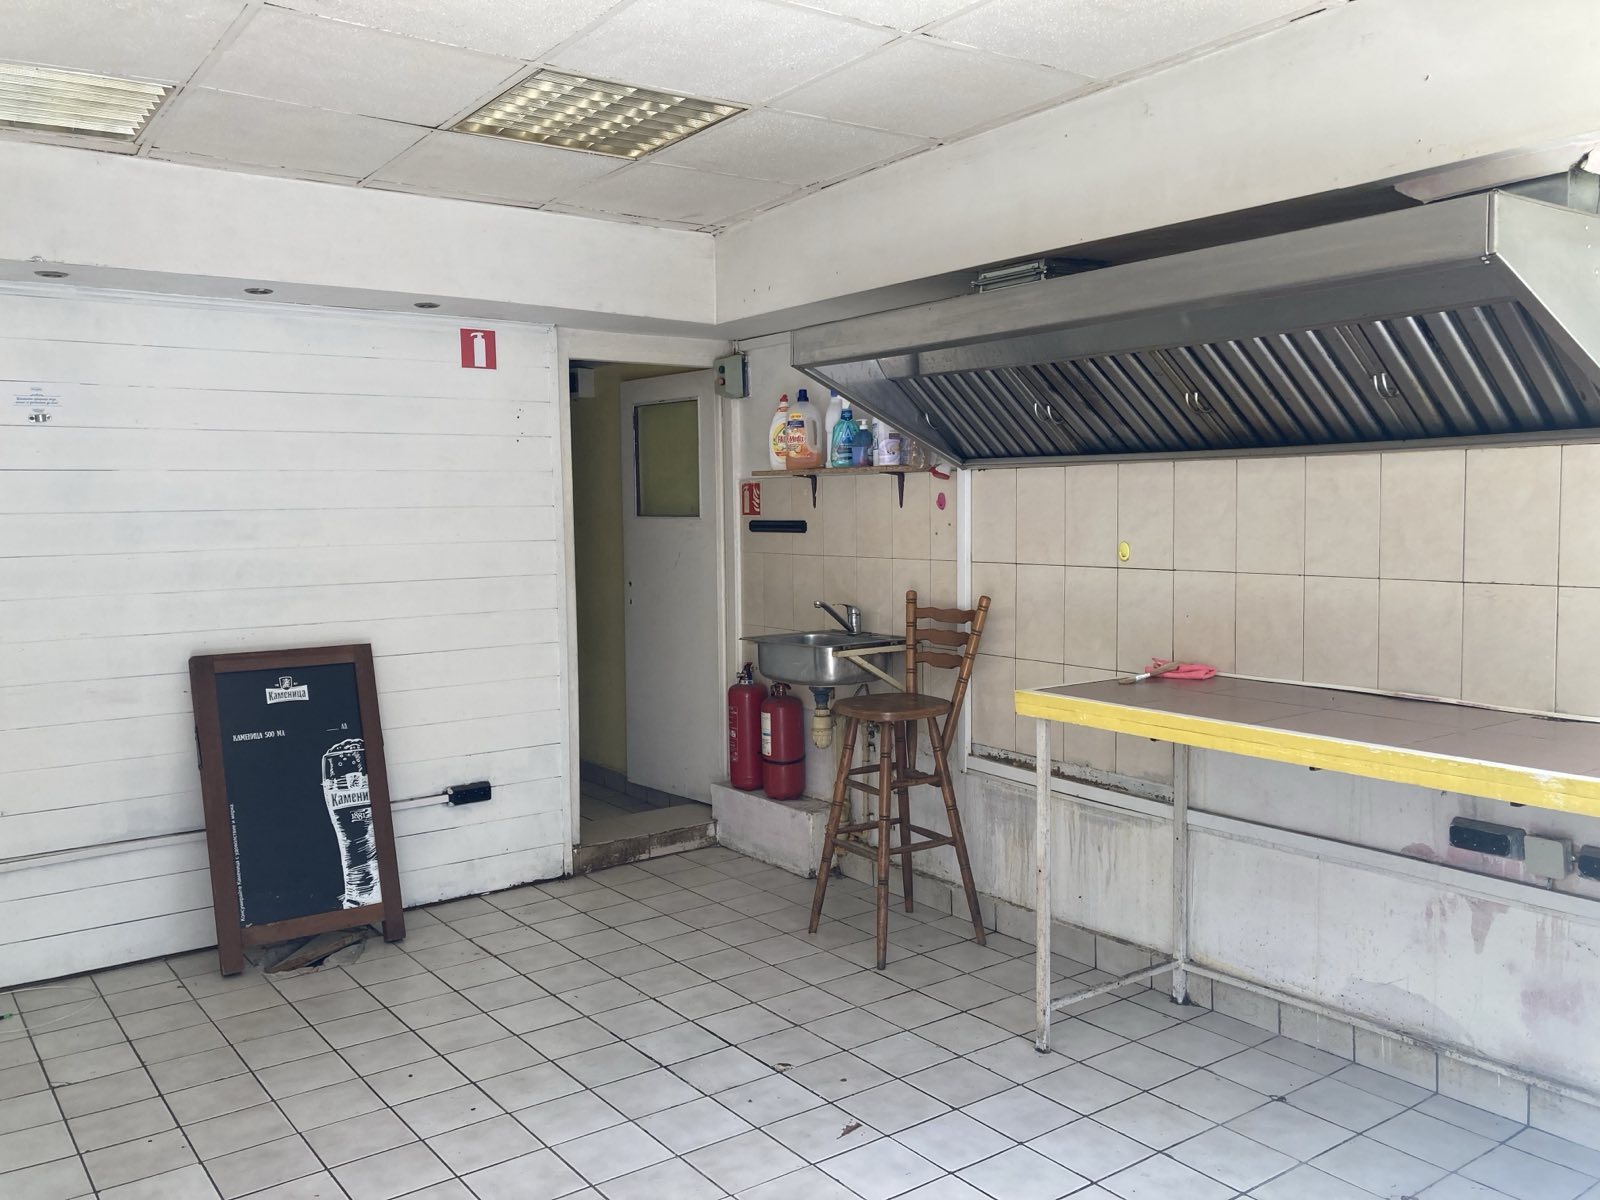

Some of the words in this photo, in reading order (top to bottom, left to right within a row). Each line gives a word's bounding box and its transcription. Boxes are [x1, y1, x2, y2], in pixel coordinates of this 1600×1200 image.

[268, 689, 306, 701] Каменица
[232, 732, 262, 742] КАМЕНИЦА
[264, 730, 274, 738] 500
